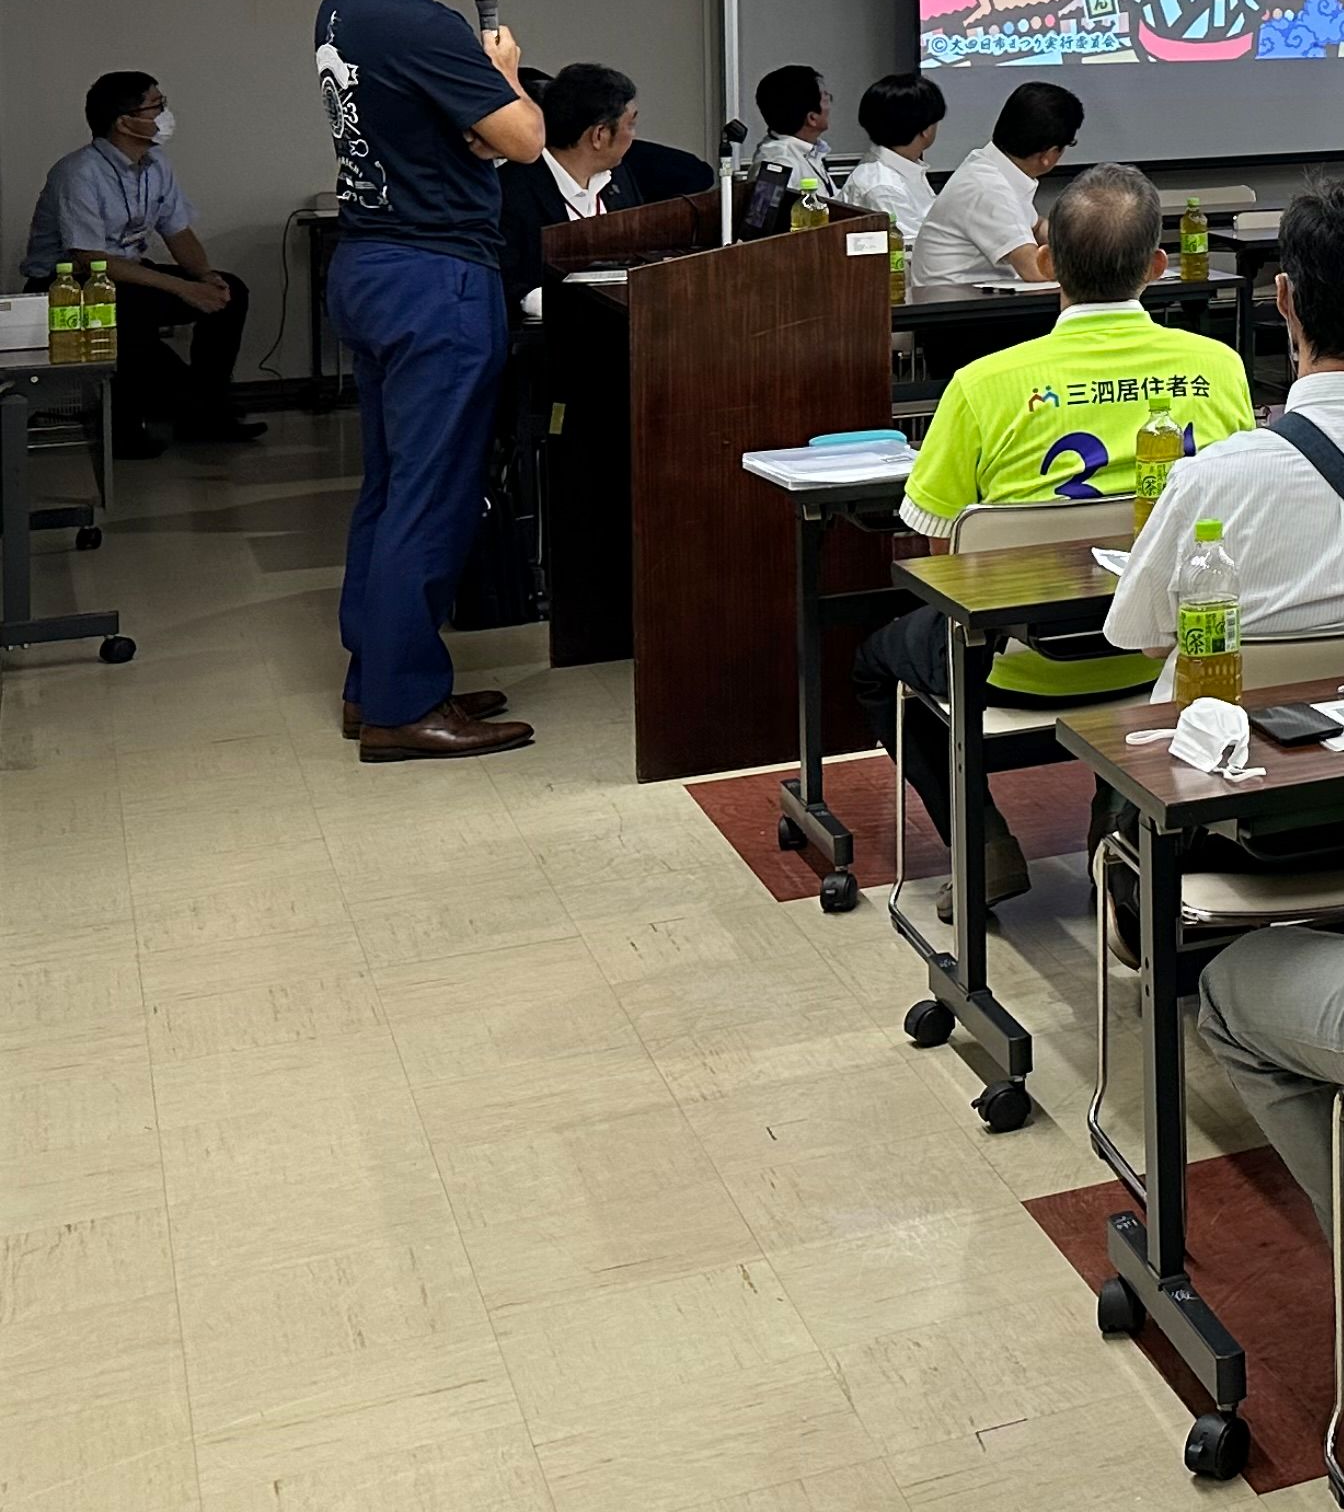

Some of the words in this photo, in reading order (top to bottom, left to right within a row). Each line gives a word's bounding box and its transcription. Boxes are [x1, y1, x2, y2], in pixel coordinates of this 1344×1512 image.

[1066, 374, 1211, 406] 三泗居住者会
